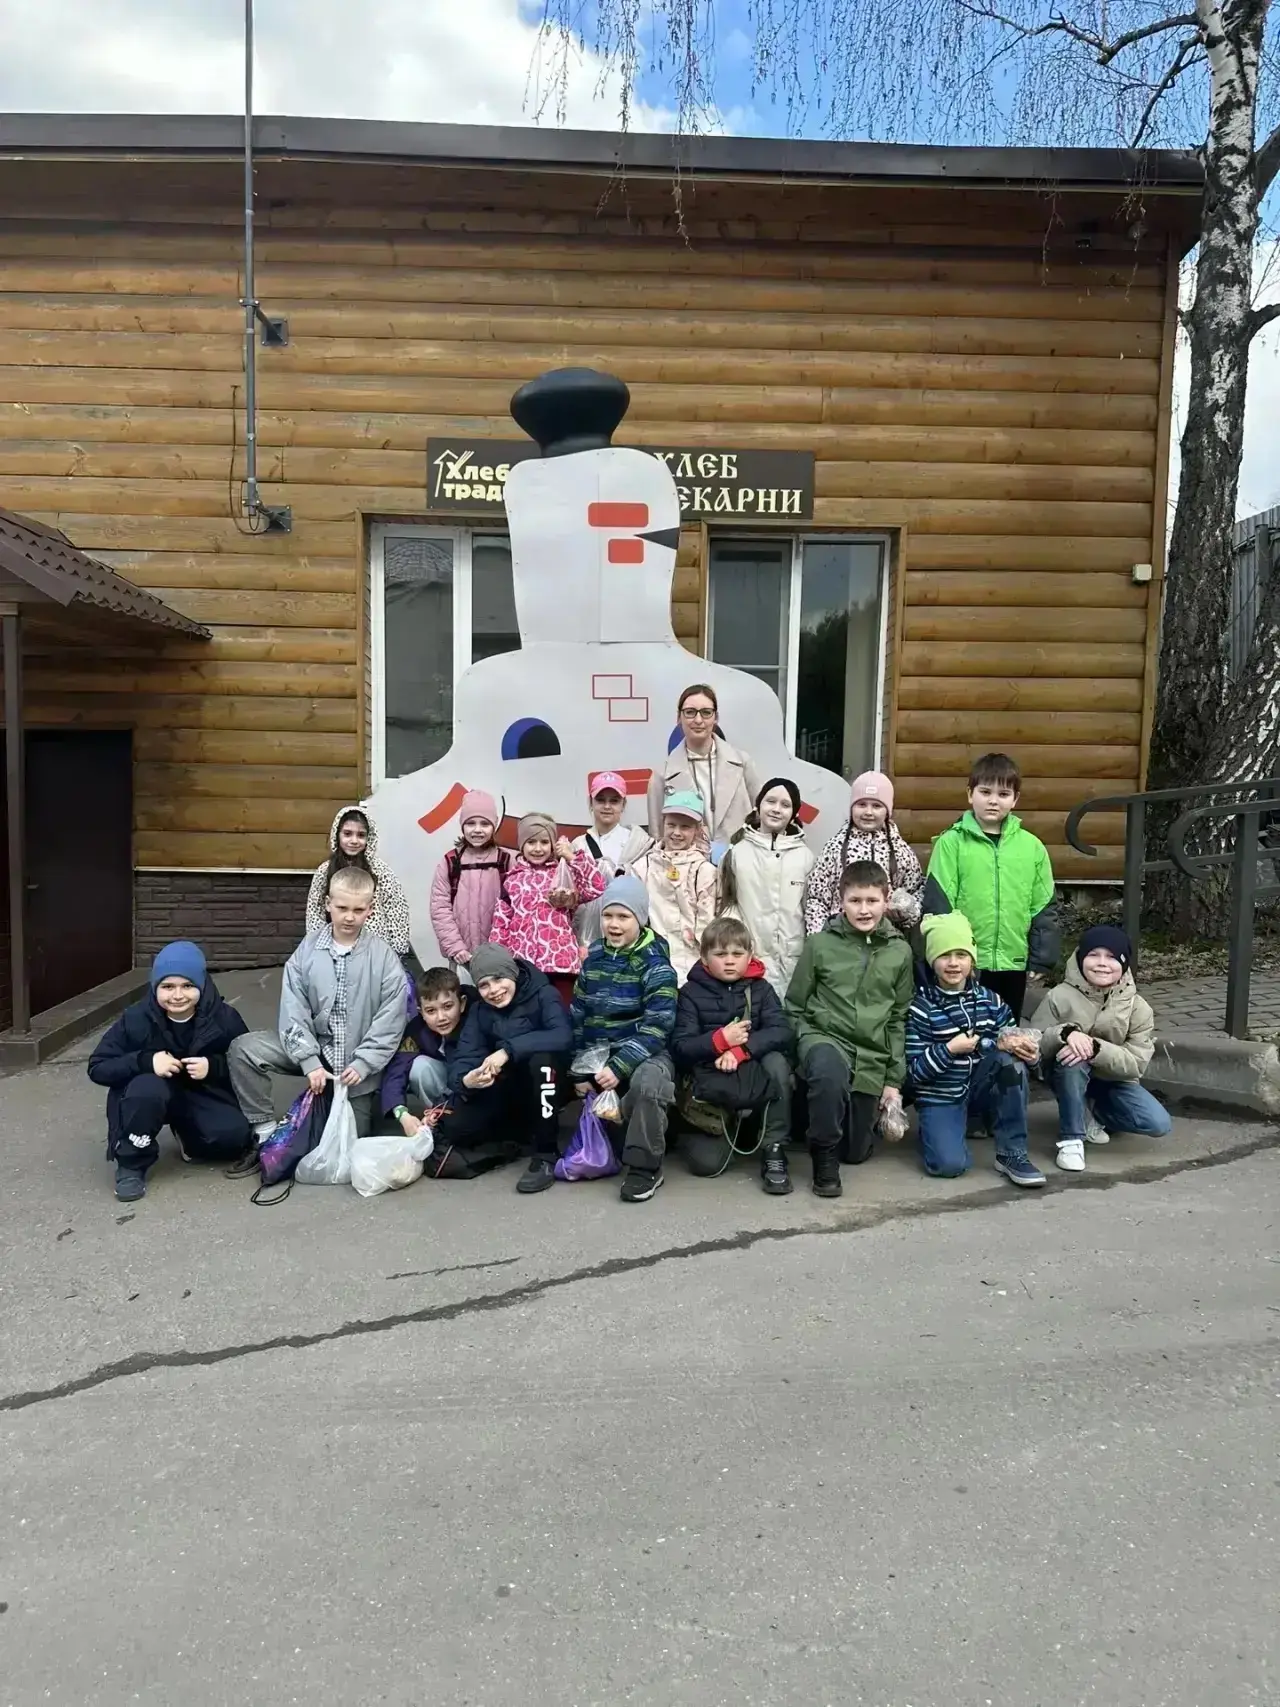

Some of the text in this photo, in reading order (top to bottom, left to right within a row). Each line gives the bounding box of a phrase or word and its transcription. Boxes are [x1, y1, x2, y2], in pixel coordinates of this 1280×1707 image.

[442, 483, 504, 502] трад
[676, 486, 803, 514] ЕКАРНИ
[540, 1066, 557, 1119] FILA
